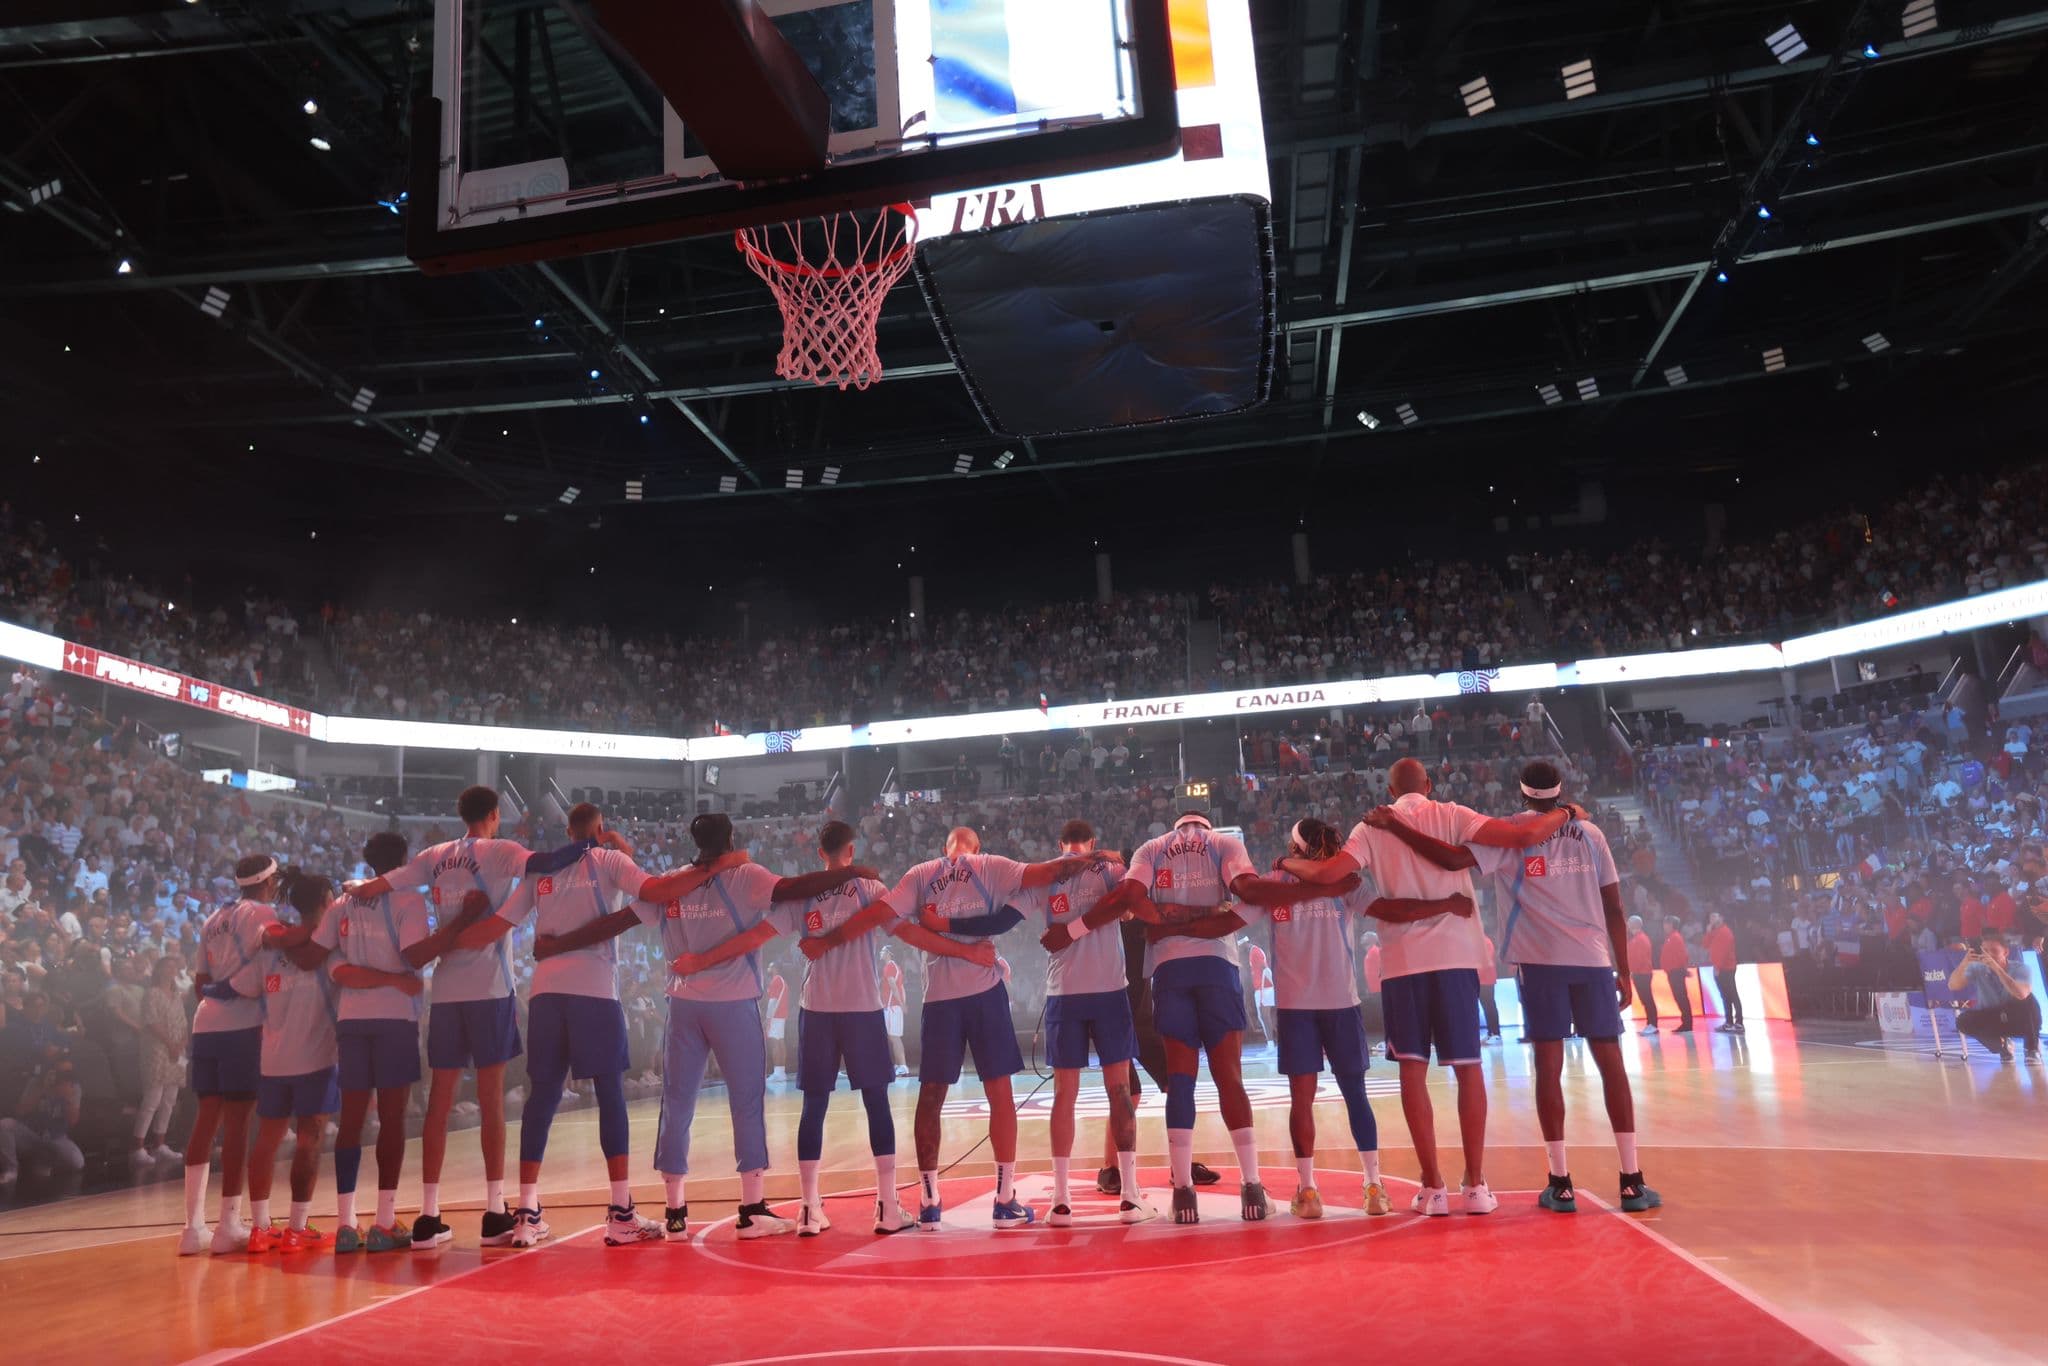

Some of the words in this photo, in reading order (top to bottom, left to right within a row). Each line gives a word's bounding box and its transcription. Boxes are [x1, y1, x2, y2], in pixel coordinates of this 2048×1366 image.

[951, 183, 1046, 233] FRA
[190, 684, 209, 702] VS
[1103, 702, 1184, 720] FRANCE
[1236, 690, 1325, 708] CANADA
